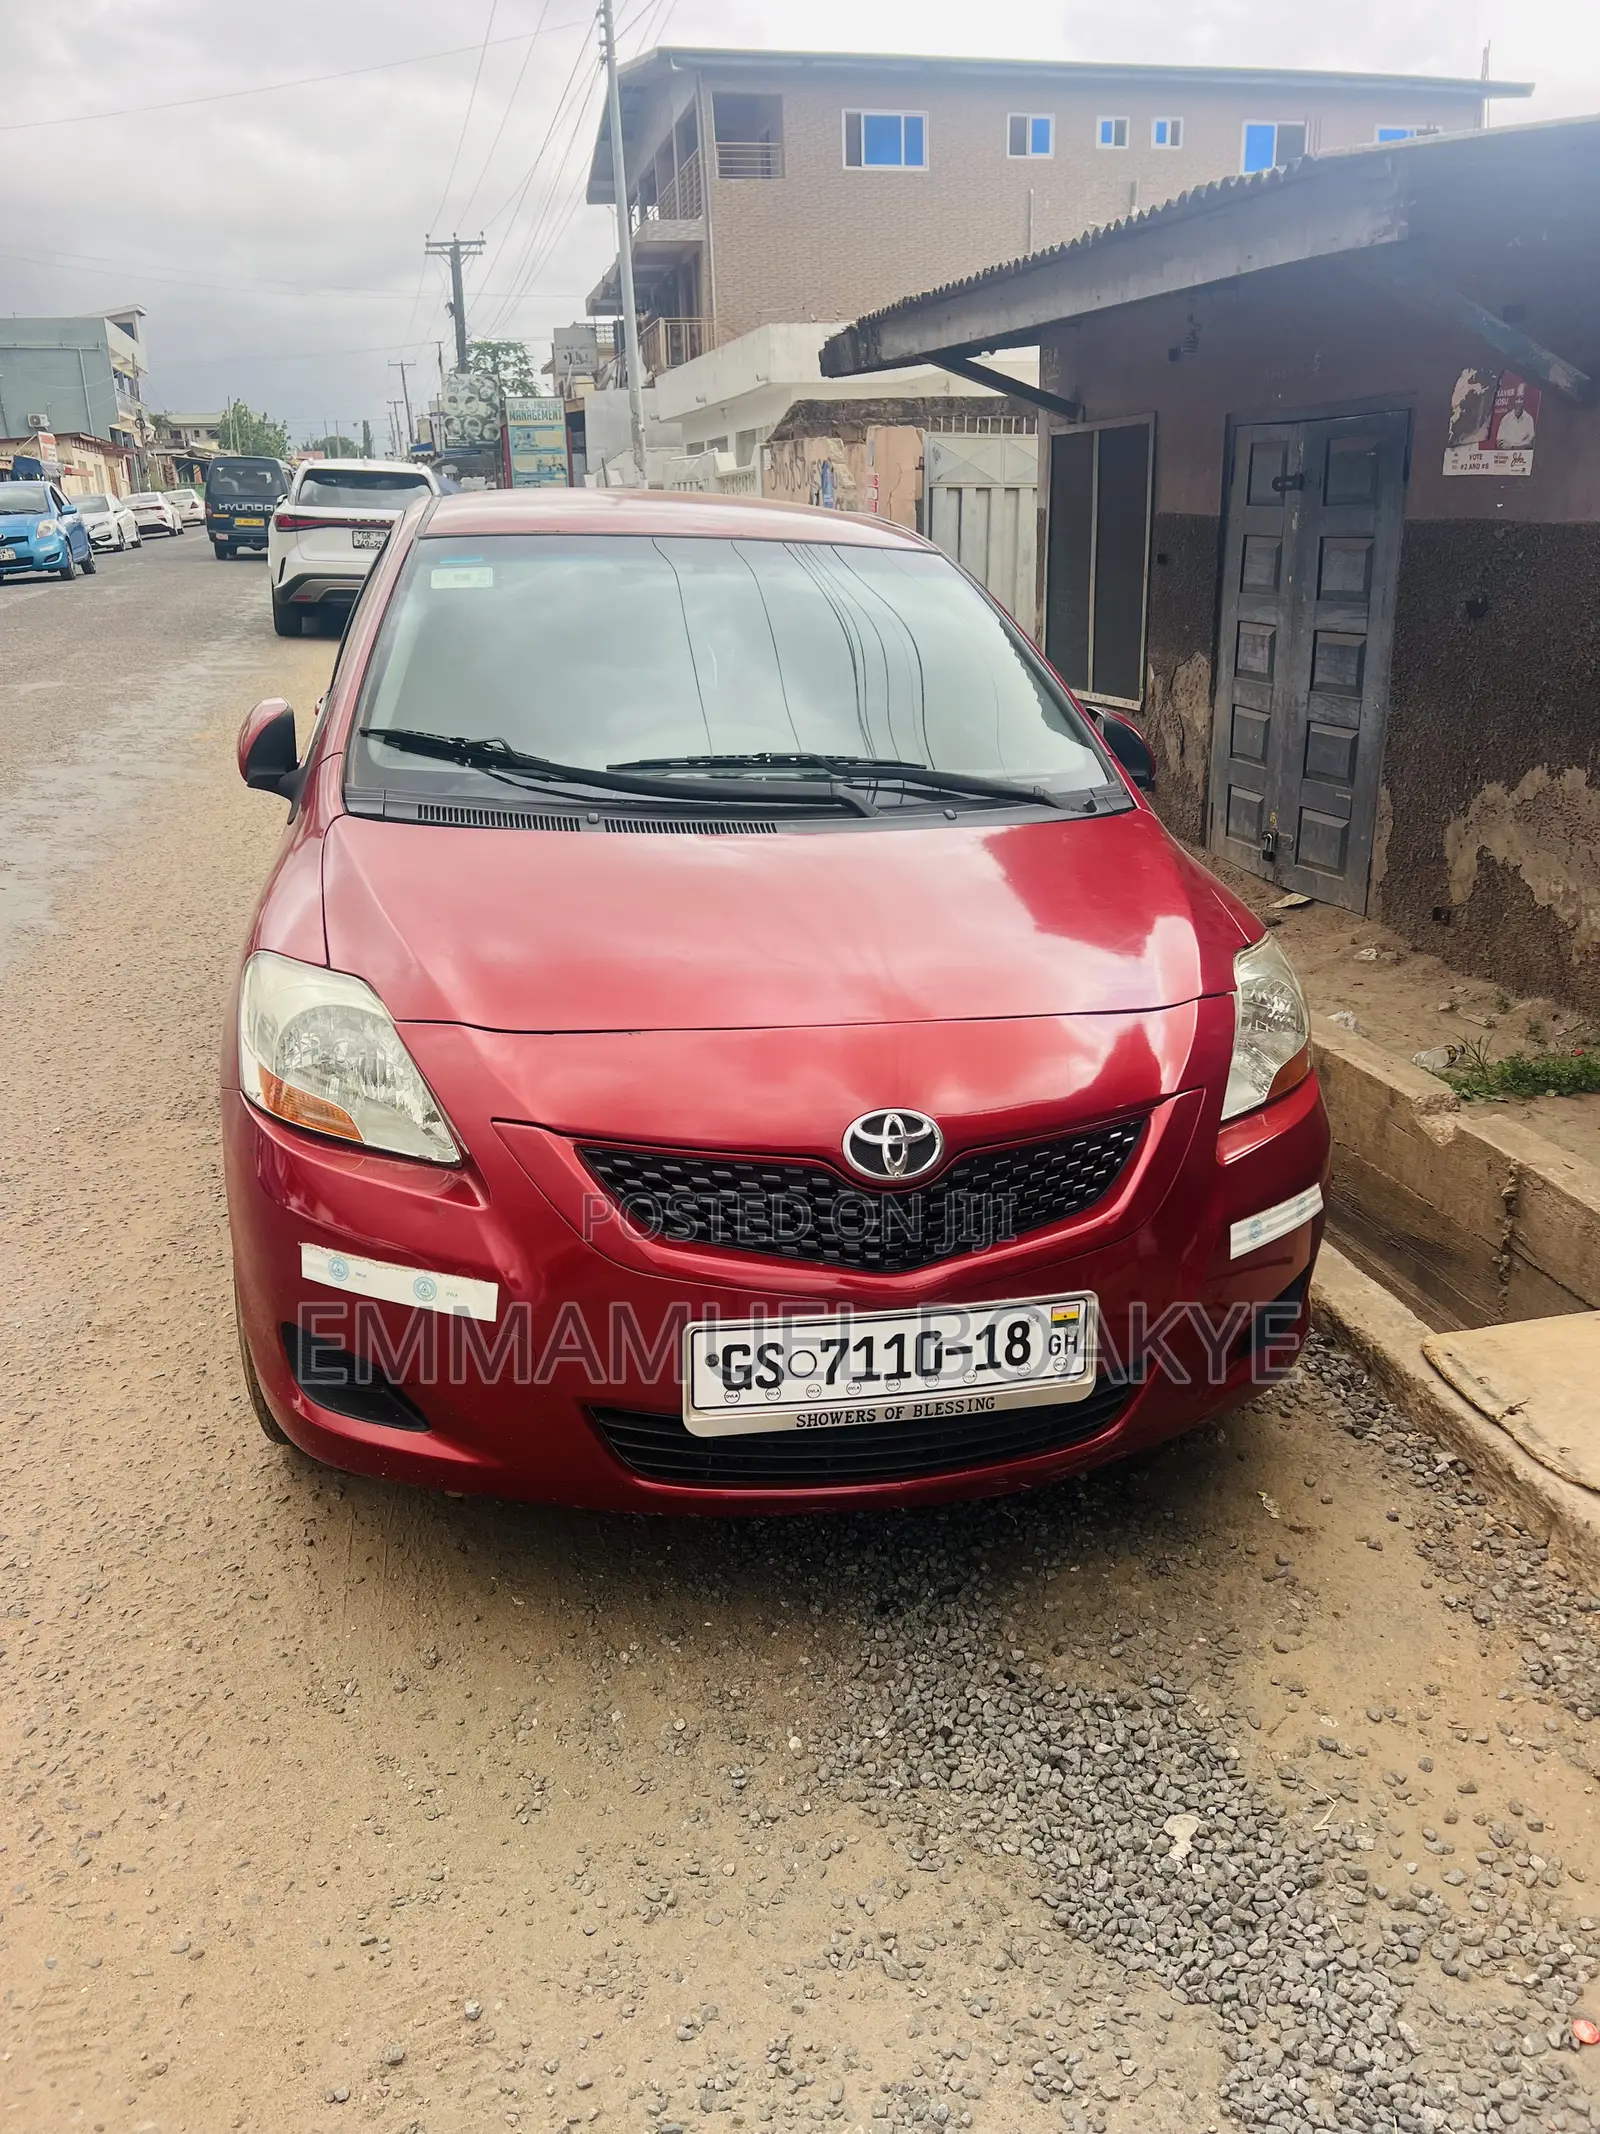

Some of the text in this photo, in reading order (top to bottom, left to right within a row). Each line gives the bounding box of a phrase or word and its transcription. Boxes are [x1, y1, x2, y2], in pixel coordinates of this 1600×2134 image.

[509, 409, 562, 421] MANAGEMENT
[1048, 1330, 1078, 1357] GH
[722, 1343, 785, 1391] GS
[796, 1396, 996, 1428] SHOWERS OF BLESSING
